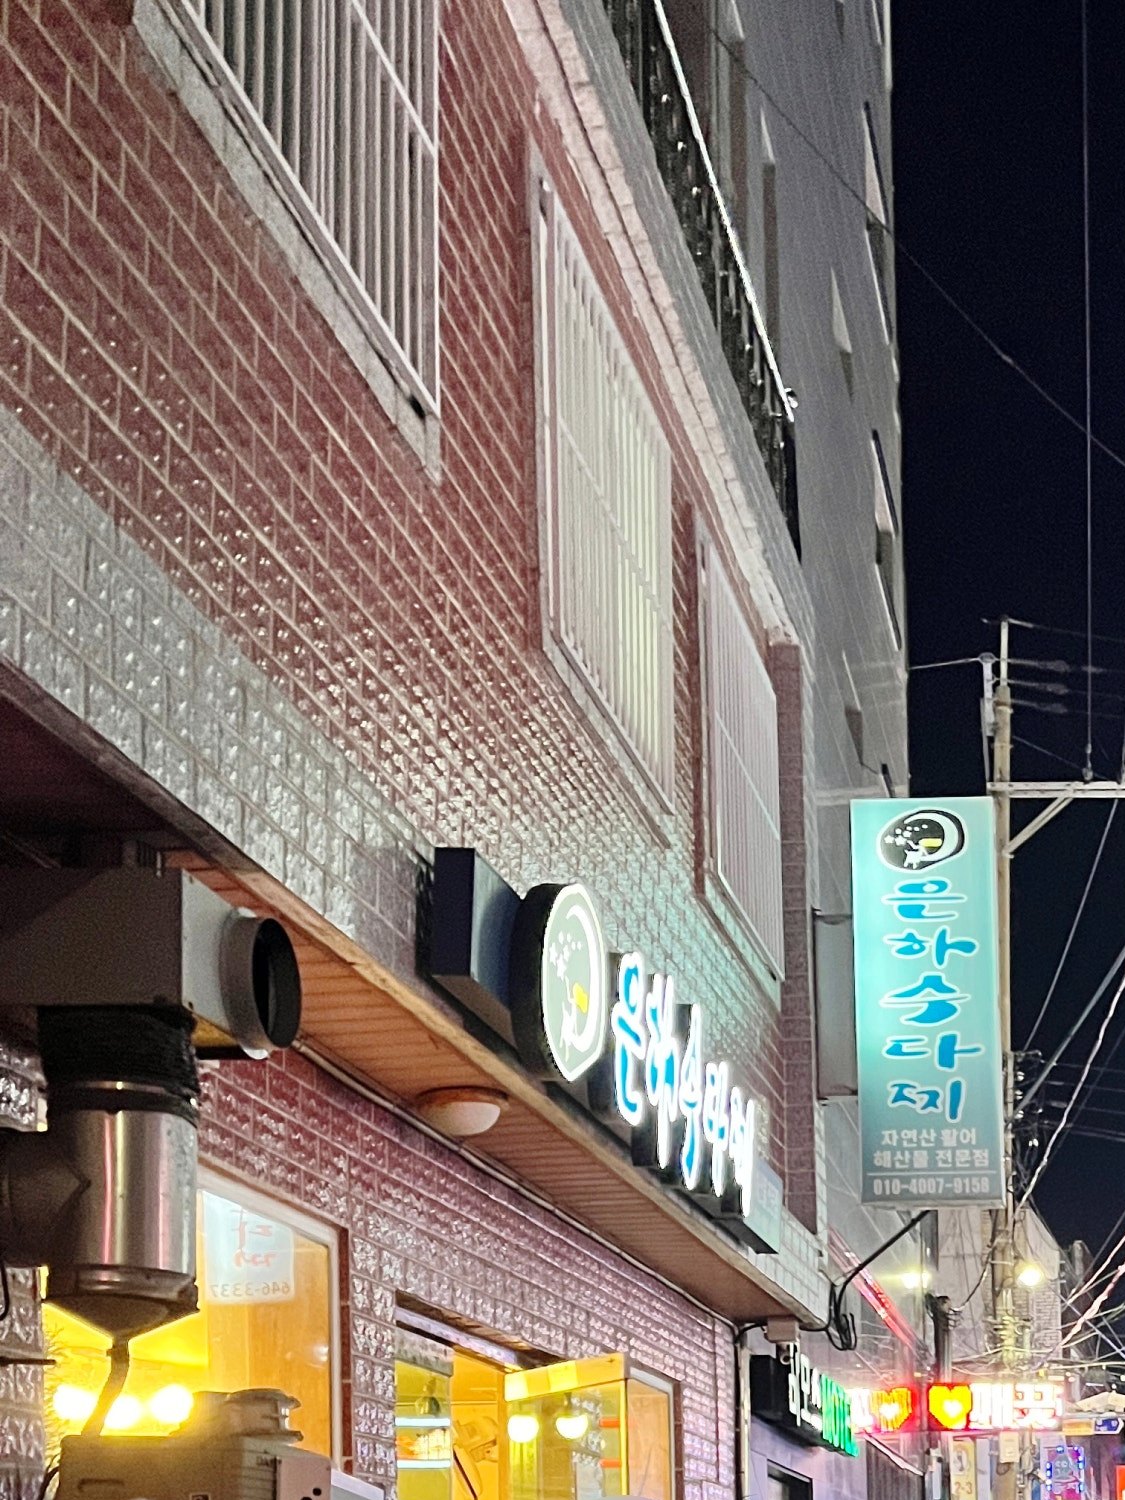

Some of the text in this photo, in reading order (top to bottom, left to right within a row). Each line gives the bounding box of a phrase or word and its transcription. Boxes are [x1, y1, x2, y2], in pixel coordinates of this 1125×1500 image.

[881, 877, 986, 1122] 은하수다찌
[881, 1127, 977, 1148] 자연산 활어
[935, 1149, 990, 1168] 전문점
